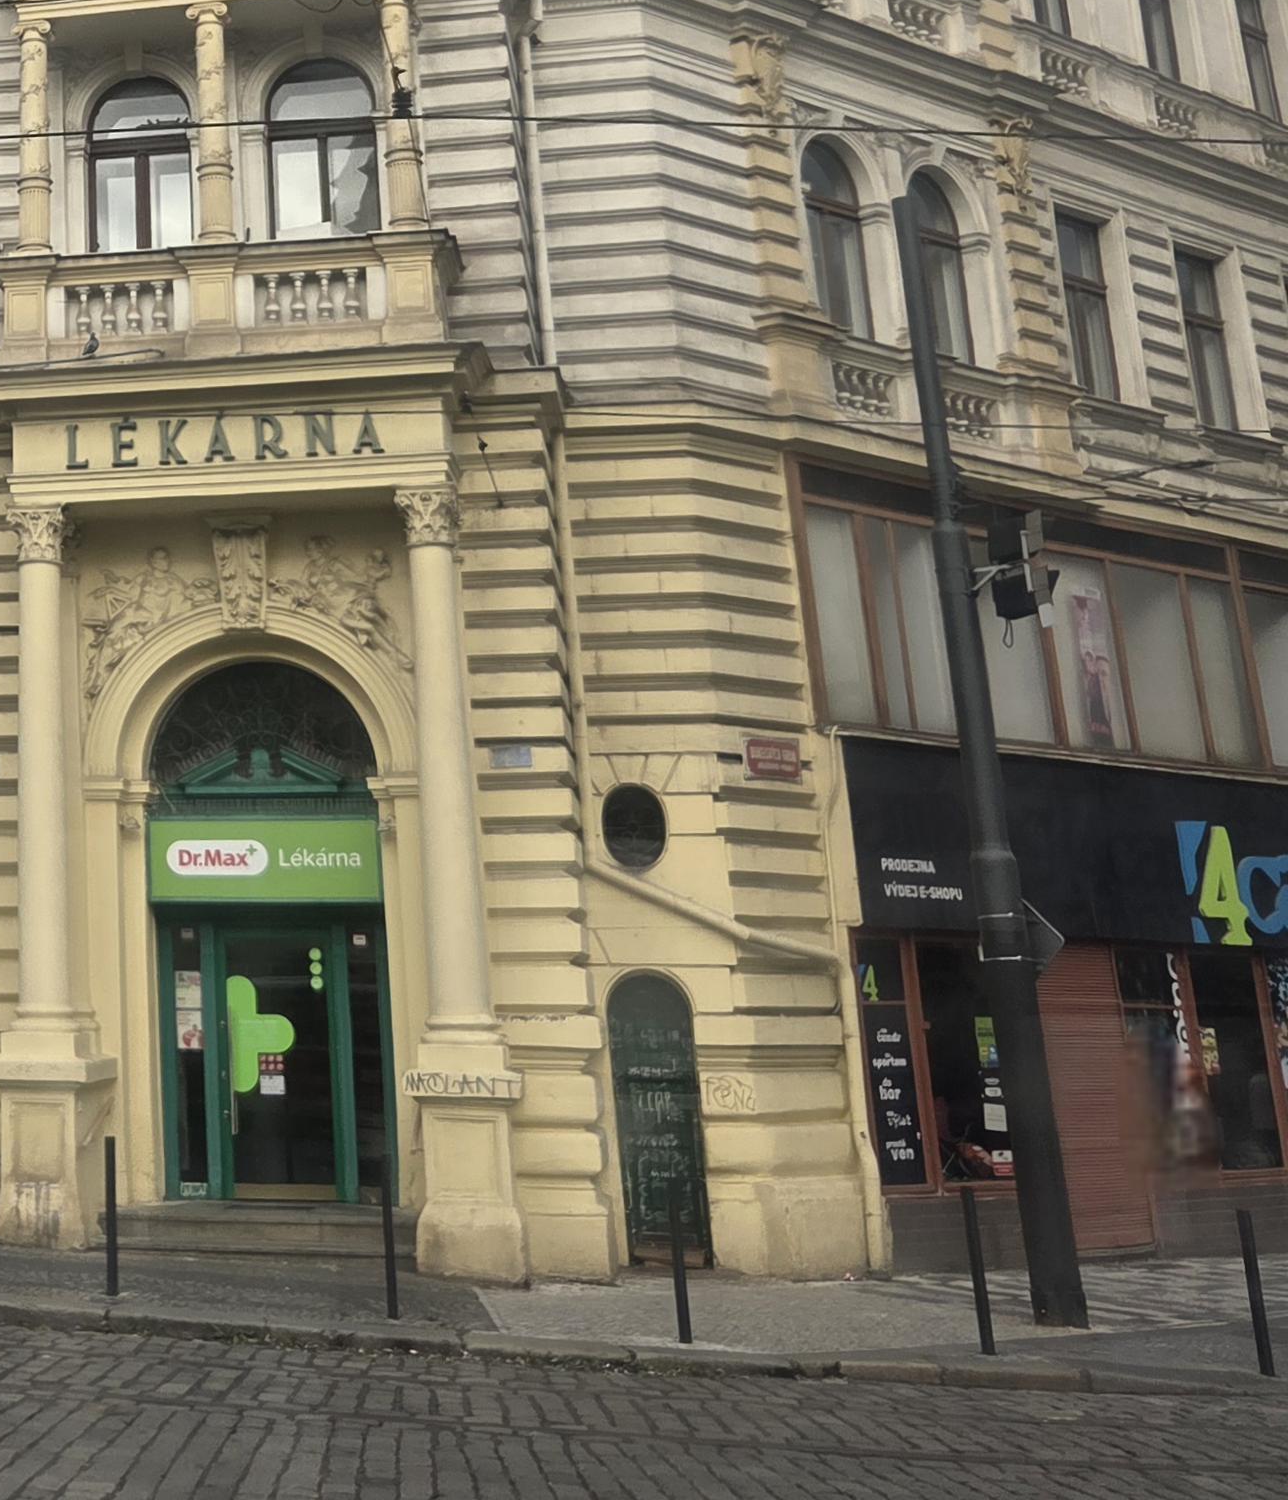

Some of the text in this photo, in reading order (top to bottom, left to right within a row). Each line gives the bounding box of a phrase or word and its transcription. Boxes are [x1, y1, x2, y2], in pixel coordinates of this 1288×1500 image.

[65, 409, 386, 470] LÉKÁRNA
[278, 847, 361, 867] Lékárna
[880, 857, 937, 874] PRODEJNA
[883, 880, 963, 901] VÝDEJ E-SHOPU
[890, 1148, 915, 1161] ven
